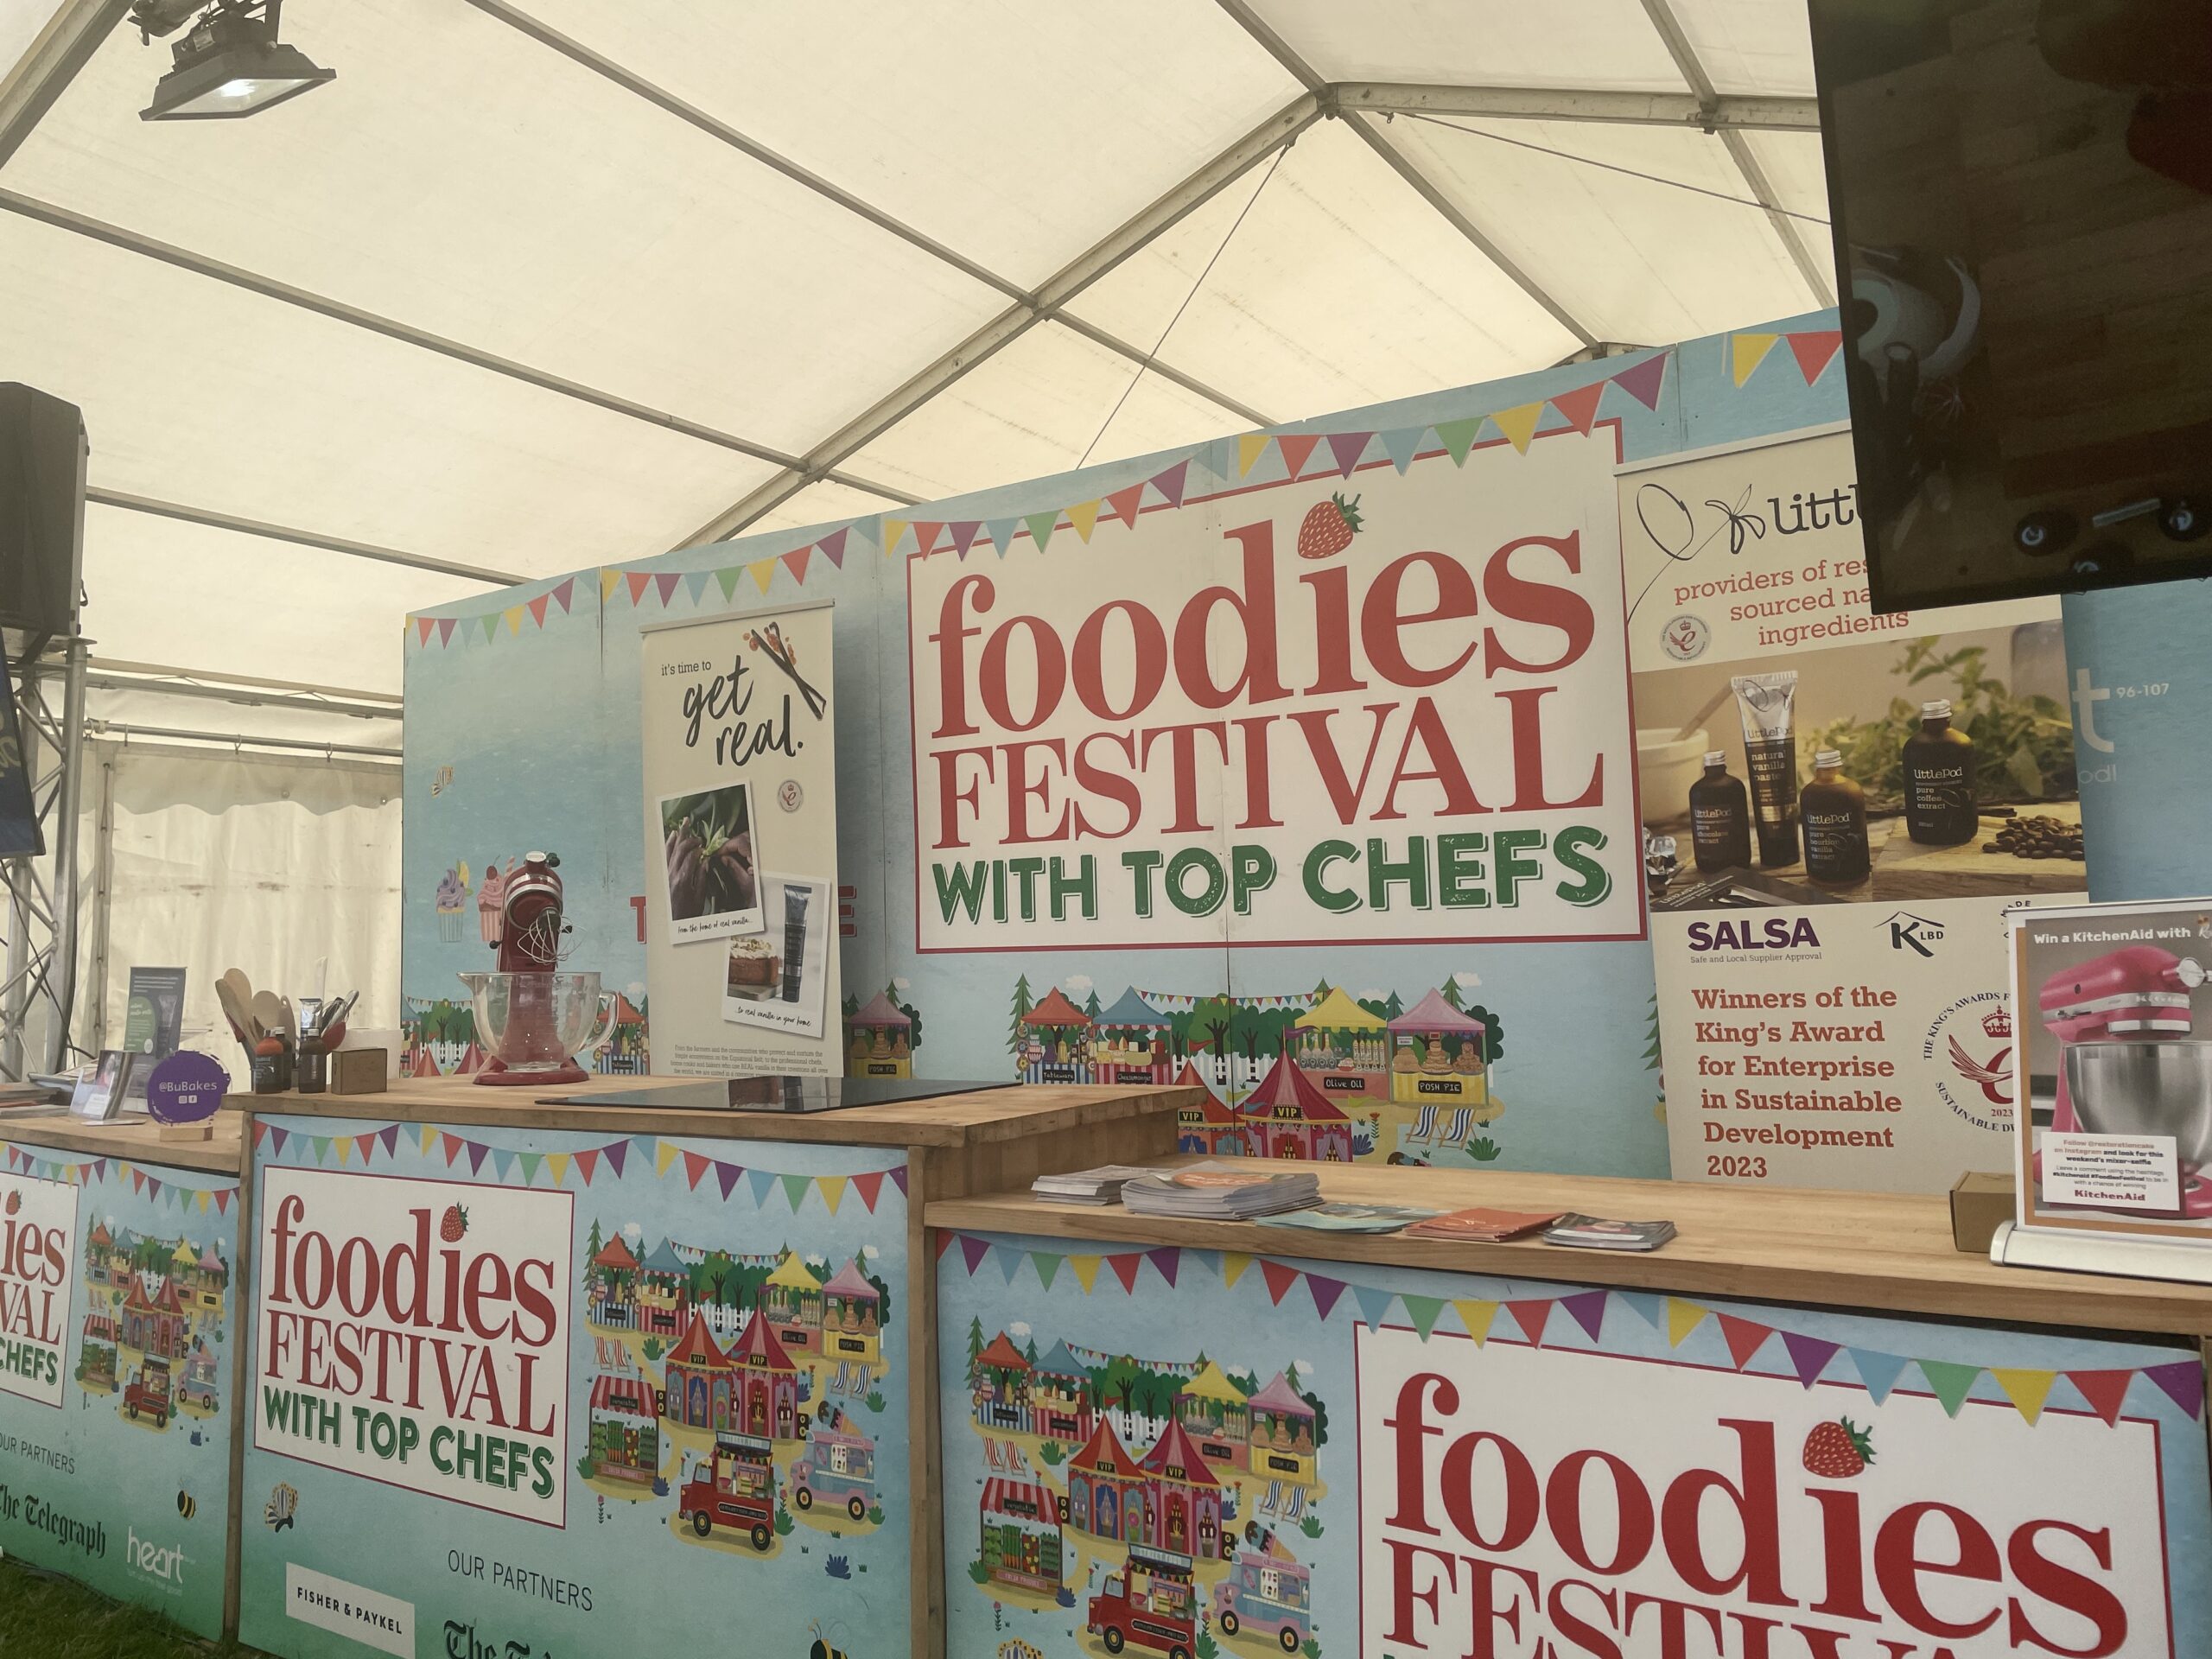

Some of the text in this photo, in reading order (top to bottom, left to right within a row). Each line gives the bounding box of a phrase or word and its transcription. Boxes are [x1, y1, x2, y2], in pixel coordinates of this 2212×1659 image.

[1674, 569, 1794, 606] providers
[1802, 559, 1827, 582] of
[1730, 588, 1834, 621] sourced
[928, 517, 1595, 740] foodies
[1758, 610, 1910, 646] ingredients
[661, 660, 712, 677] it's time to
[683, 655, 754, 747] get
[2117, 683, 2170, 699] 96-107
[715, 694, 804, 766] real.
[929, 686, 1605, 850] FESTIVAL
[932, 854, 1097, 926] WITH
[1122, 844, 1277, 918] TOP
[1302, 825, 1613, 914] CHEFS
[1688, 918, 1821, 951] SALSA
[2033, 933, 2059, 944] Win
[2073, 929, 2153, 943] KitchenAid
[2157, 927, 2191, 939] with
[1726, 954, 1747, 963] Local
[1750, 953, 1783, 963] Supplier
[1785, 951, 1822, 963] Approval
[1692, 985, 1897, 1010] Winners of the
[1695, 1020, 1885, 1046] King's Award
[1923, 992, 2000, 1060] THE KING'S AWARDS
[1325, 1079, 1363, 1089] Olive Oil
[1698, 1055, 1895, 1081] for Enterprise
[158, 1080, 218, 1093] @BuBakes
[1420, 1082, 1461, 1092] POSH PIE
[1700, 1088, 1903, 1113] in Sustainable
[1182, 1112, 1200, 1121] VIP
[1278, 1107, 1298, 1118] VIP
[1935, 1081, 1999, 1133] SUSTAINABLE
[1991, 1109, 2013, 1117] 2023
[1704, 1122, 1894, 1150] Development
[1707, 1155, 1768, 1179] 2023
[2075, 1189, 2145, 1201] KitchenAid
[268, 1194, 558, 1347] foodies
[264, 1308, 557, 1438] FESTIVAL
[751, 1356, 766, 1366] VIP
[21, 1440, 76, 1475] PARTNERS
[264, 1385, 556, 1500] WITH TOP CHEFS
[1168, 1466, 1183, 1477] VIP
[24, 1494, 106, 1560] Telegraph
[1383, 1372, 2129, 1658] foodies
[127, 1525, 184, 1584] heart
[448, 1549, 594, 1612] OUR PARTNERS
[297, 1586, 403, 1635] FISHER & PAYKEL
